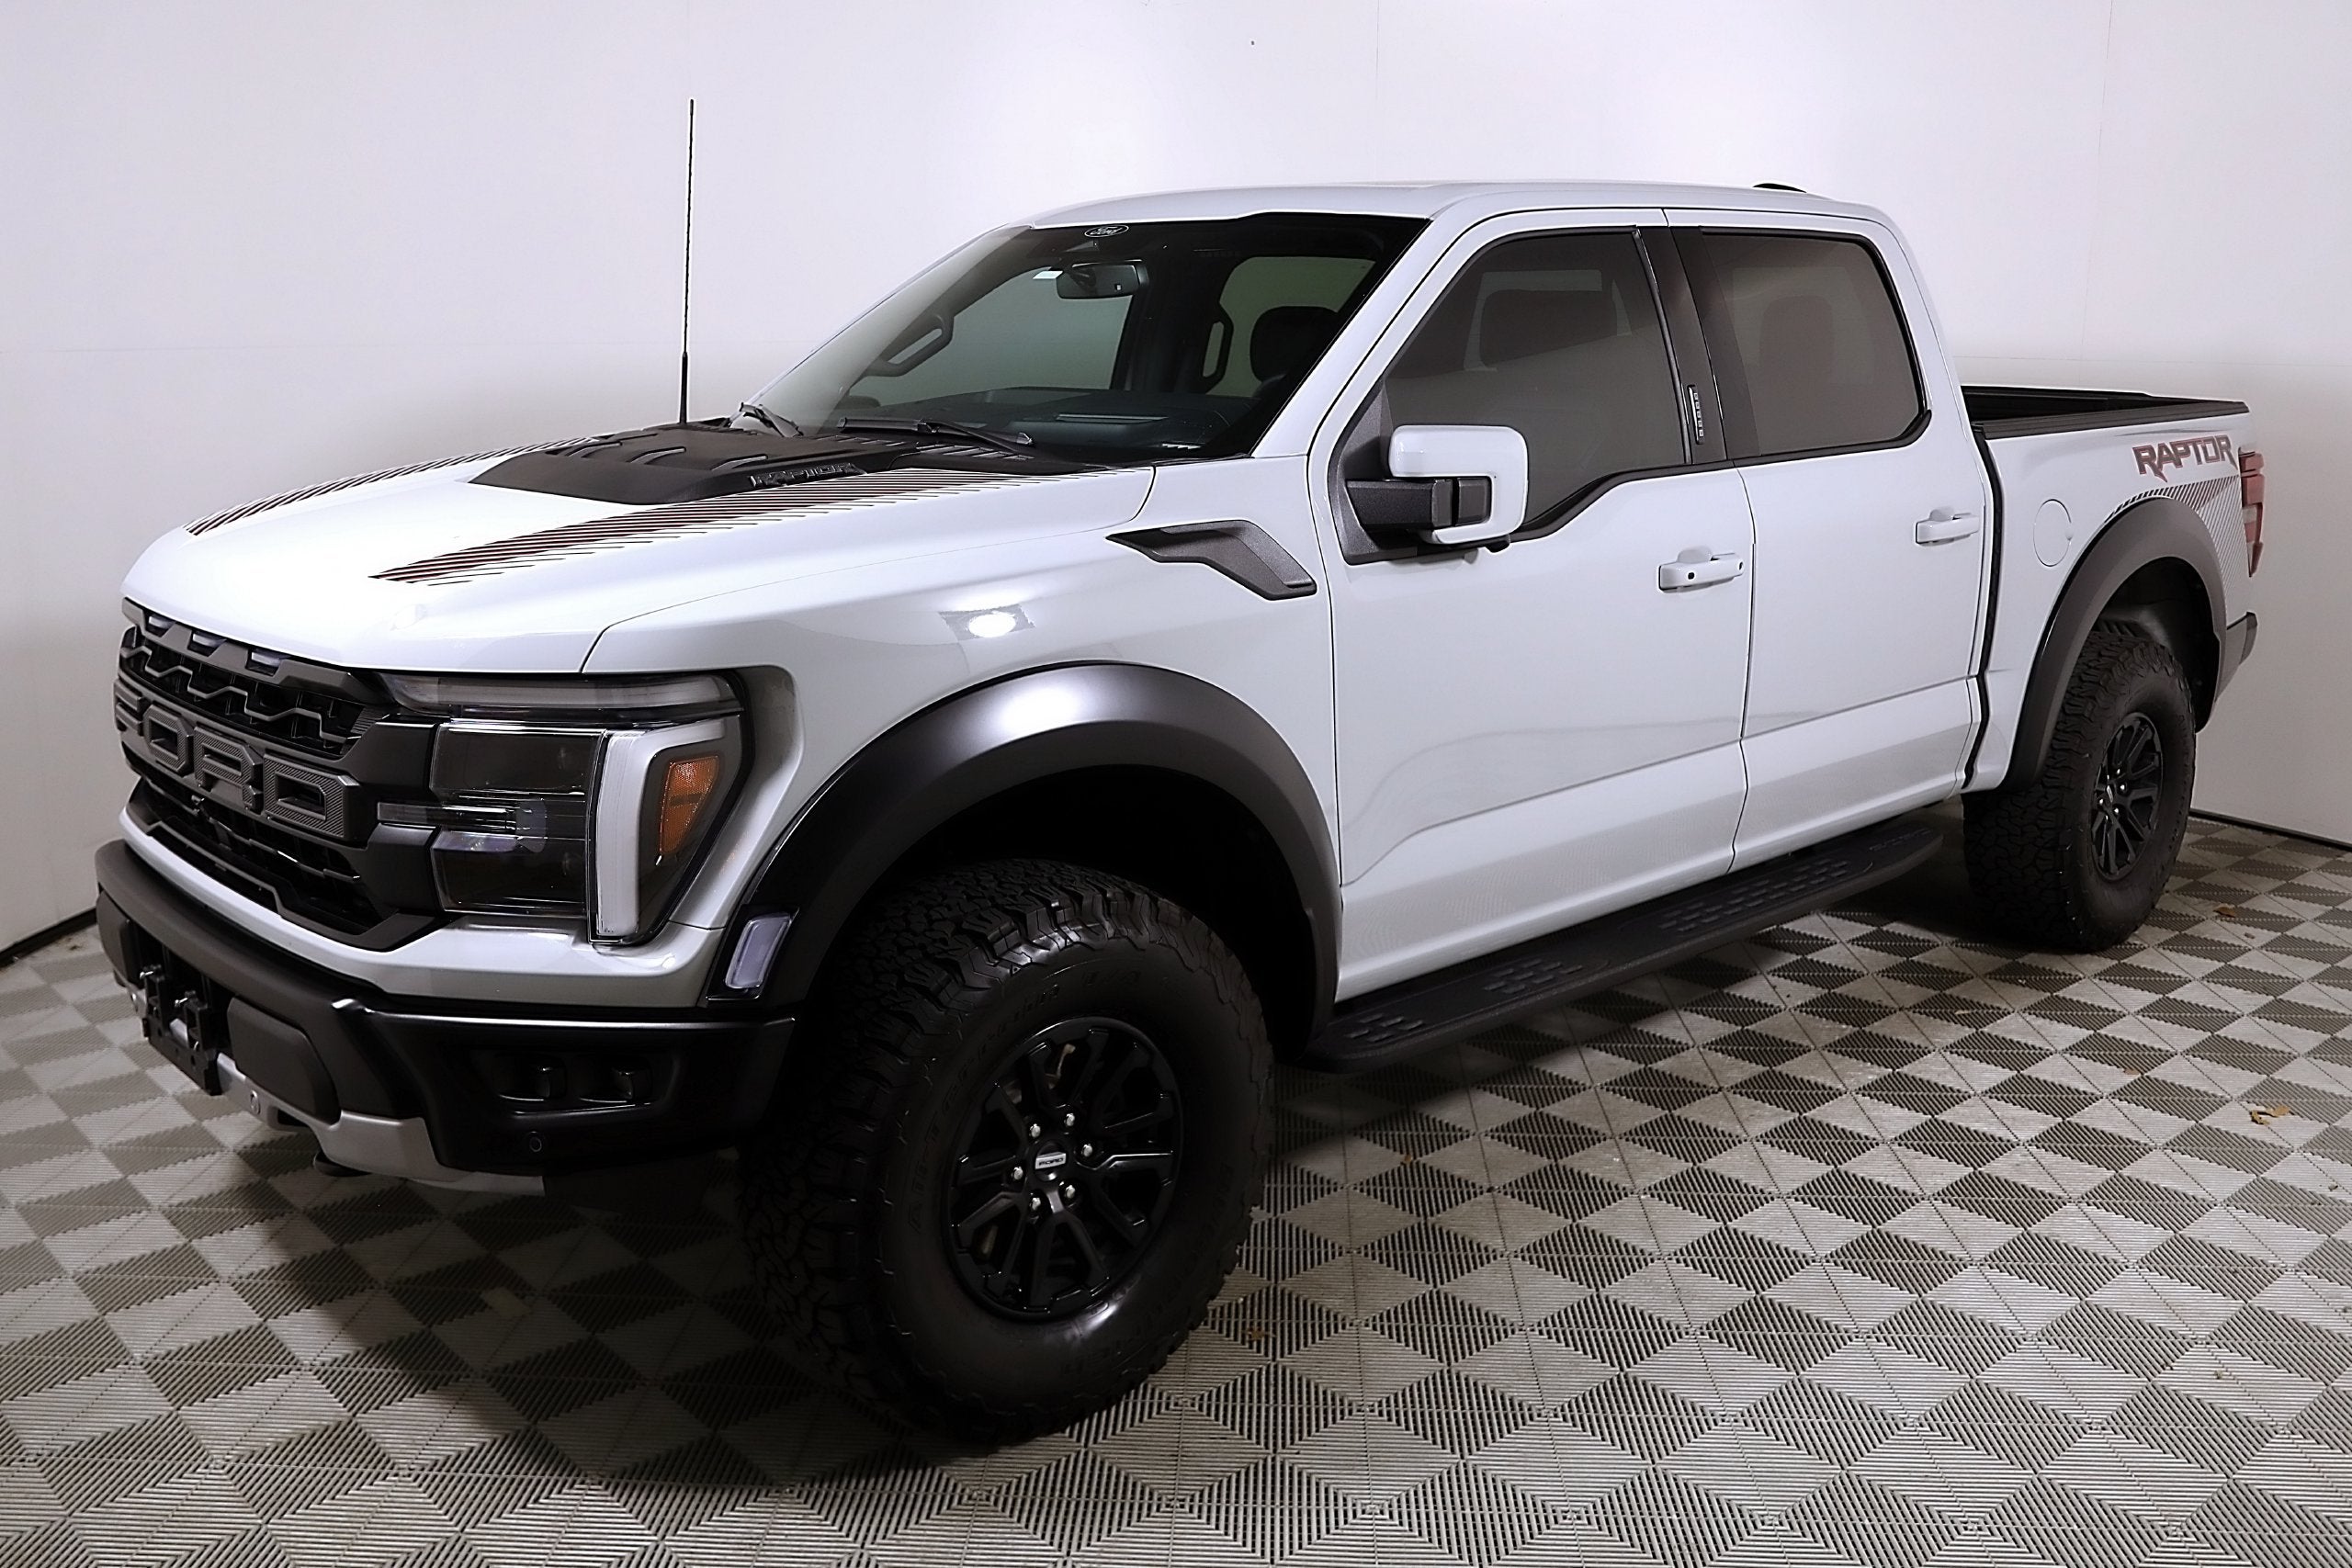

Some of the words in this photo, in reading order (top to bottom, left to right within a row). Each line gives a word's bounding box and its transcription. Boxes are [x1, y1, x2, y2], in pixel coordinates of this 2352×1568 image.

[2132, 434, 2239, 483] RAPTOR
[749, 462, 868, 487] RAPTOR
[1038, 1156, 1065, 1167] FORD
